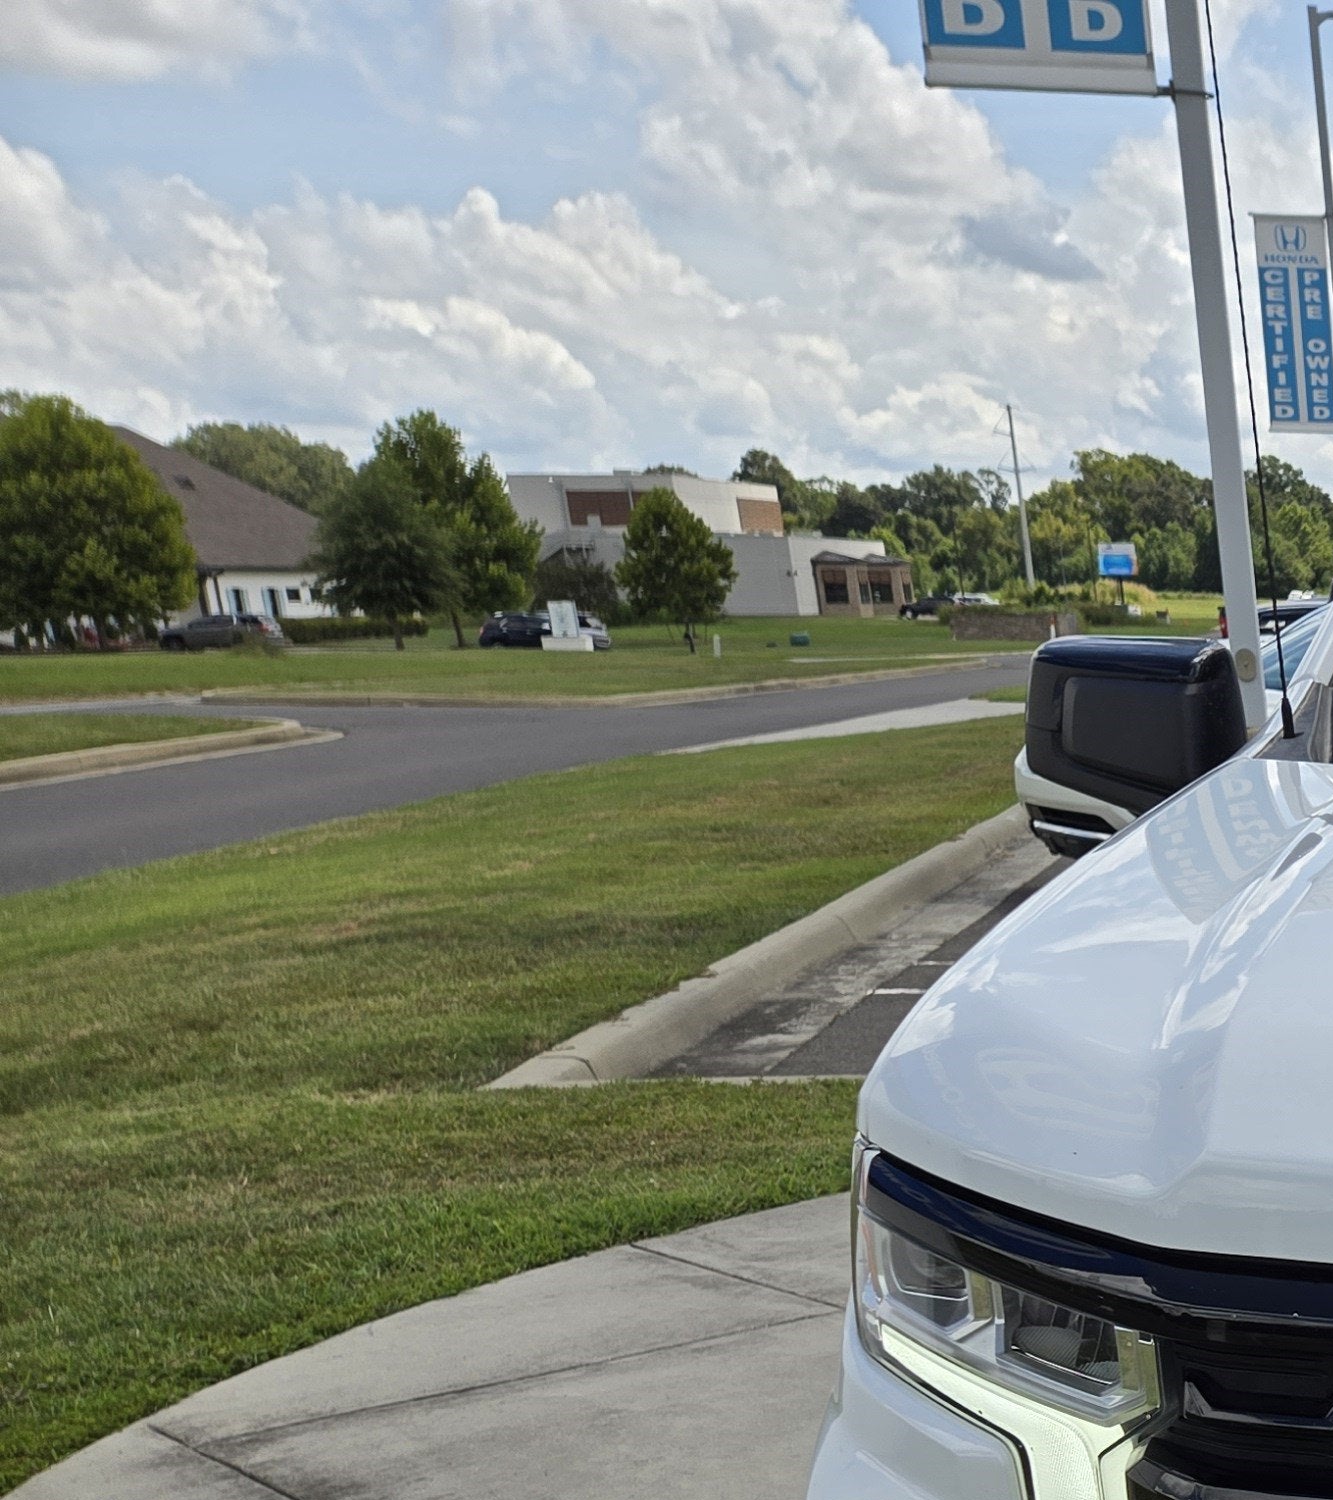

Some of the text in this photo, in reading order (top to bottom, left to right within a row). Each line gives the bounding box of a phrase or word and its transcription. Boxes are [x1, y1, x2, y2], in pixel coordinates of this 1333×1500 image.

[1264, 253, 1319, 264] HONDA
[1263, 270, 1295, 419] CERTIFIED
[1303, 270, 1331, 420] PRE OWNED
